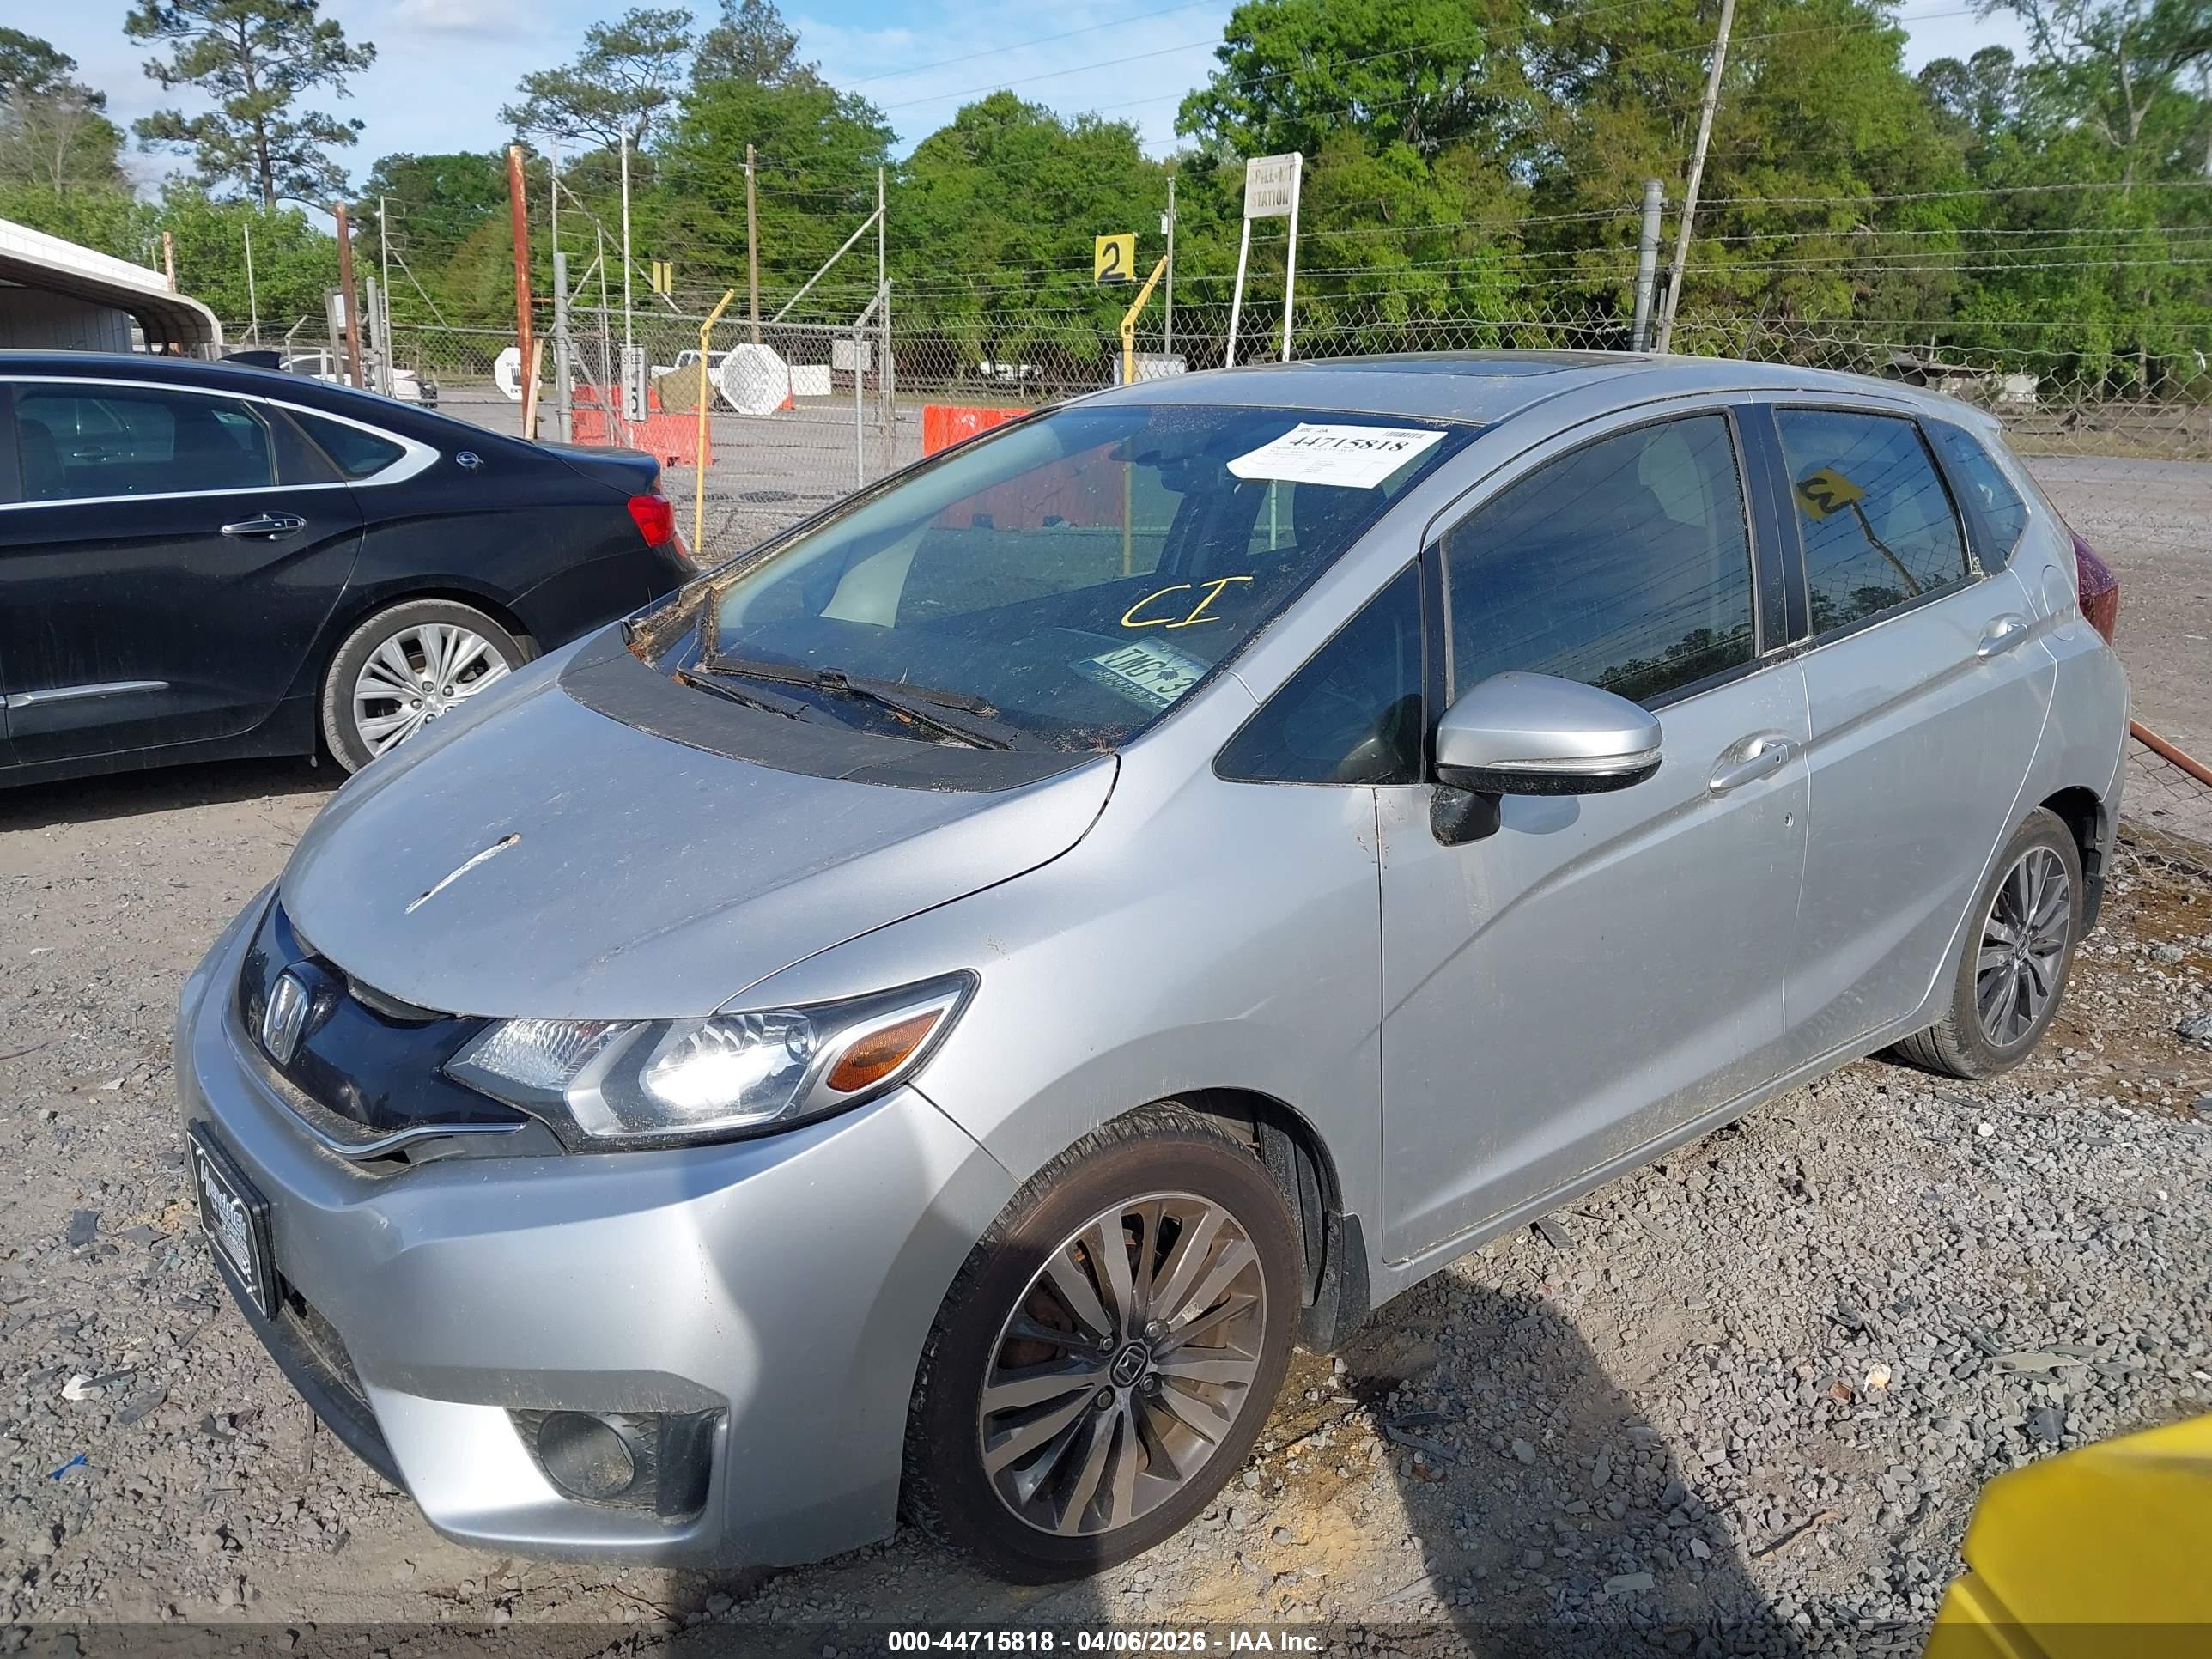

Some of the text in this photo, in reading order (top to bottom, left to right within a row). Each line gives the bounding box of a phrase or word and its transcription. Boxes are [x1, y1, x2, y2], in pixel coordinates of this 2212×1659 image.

[1250, 189, 1289, 207] STATION
[1098, 242, 1126, 280] 2
[1289, 436, 1409, 452] 44715818
[1121, 576, 1253, 629] CI
[1104, 648, 1167, 677] TMG
